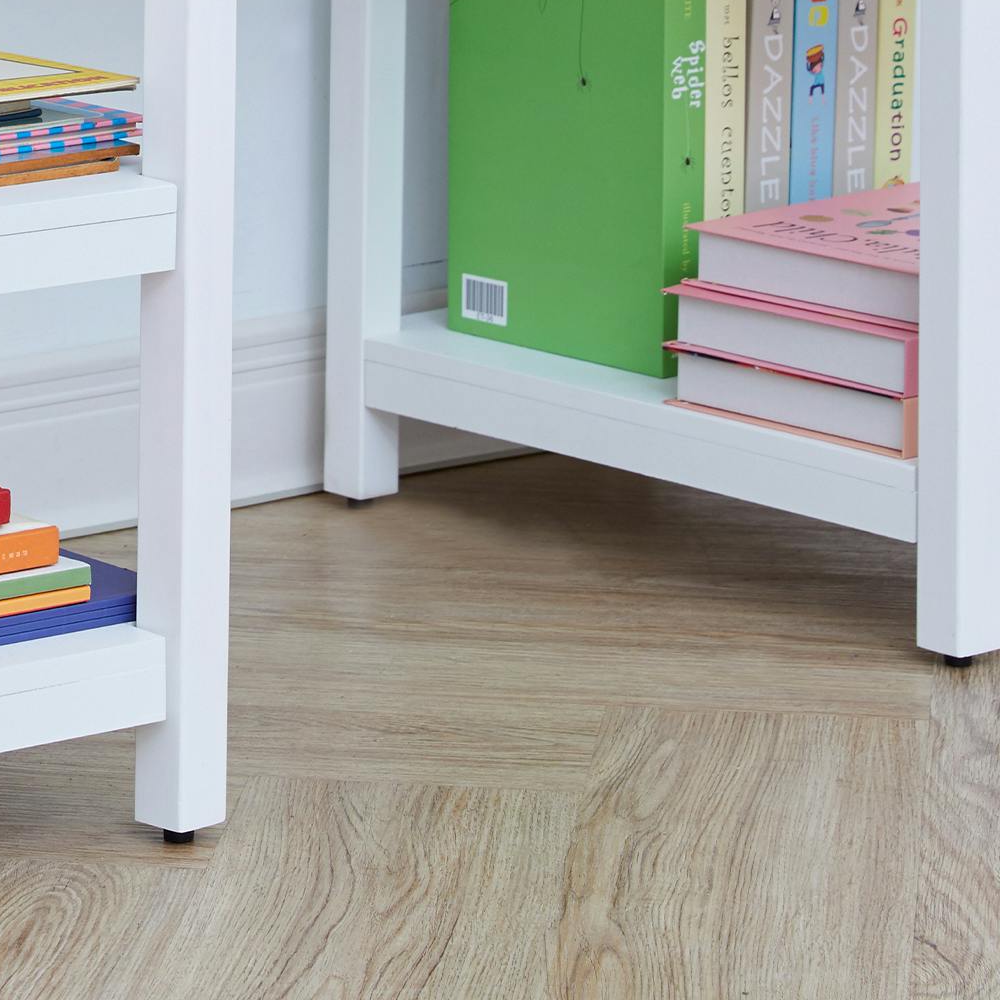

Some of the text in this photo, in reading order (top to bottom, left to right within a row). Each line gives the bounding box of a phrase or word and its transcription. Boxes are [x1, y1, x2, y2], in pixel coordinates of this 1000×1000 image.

[671, 56, 690, 100] web
[687, 40, 706, 109] Spider
[720, 36, 740, 109] bellos
[760, 34, 784, 204] DAZZLE
[847, 25, 869, 193] DAZZLE
[889, 17, 909, 162] Graduation
